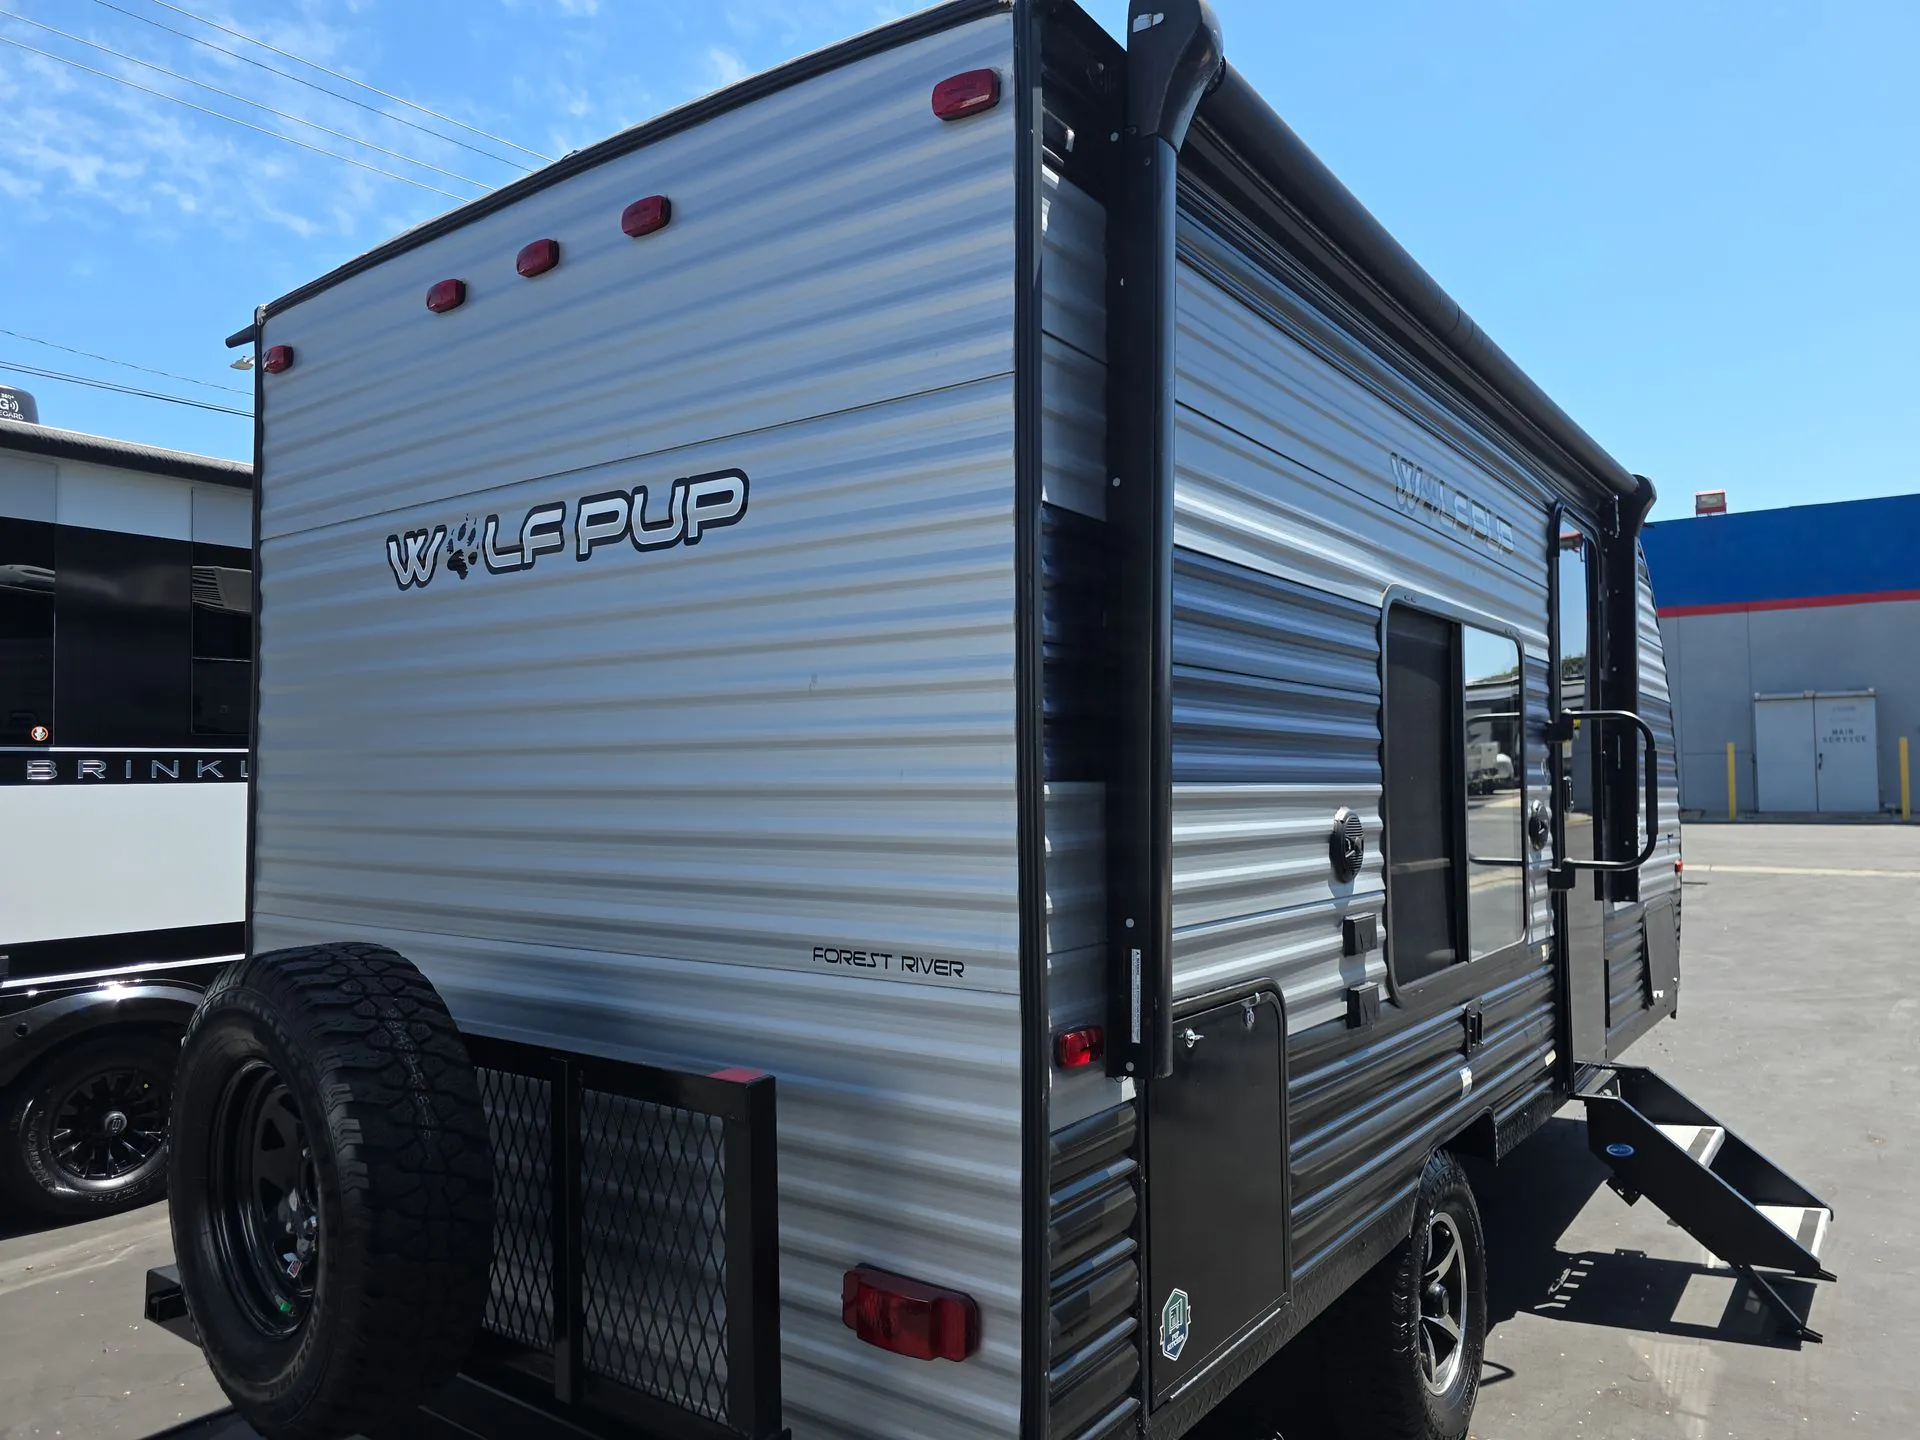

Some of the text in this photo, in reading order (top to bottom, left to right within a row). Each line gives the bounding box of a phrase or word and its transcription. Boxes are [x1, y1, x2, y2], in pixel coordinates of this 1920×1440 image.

[575, 468, 750, 562] PUP
[1470, 499, 1515, 560] PUP
[1822, 735, 1866, 744] SERVICE
[1832, 728, 1854, 736] MAIN
[813, 947, 965, 978] FOREST RIVER
